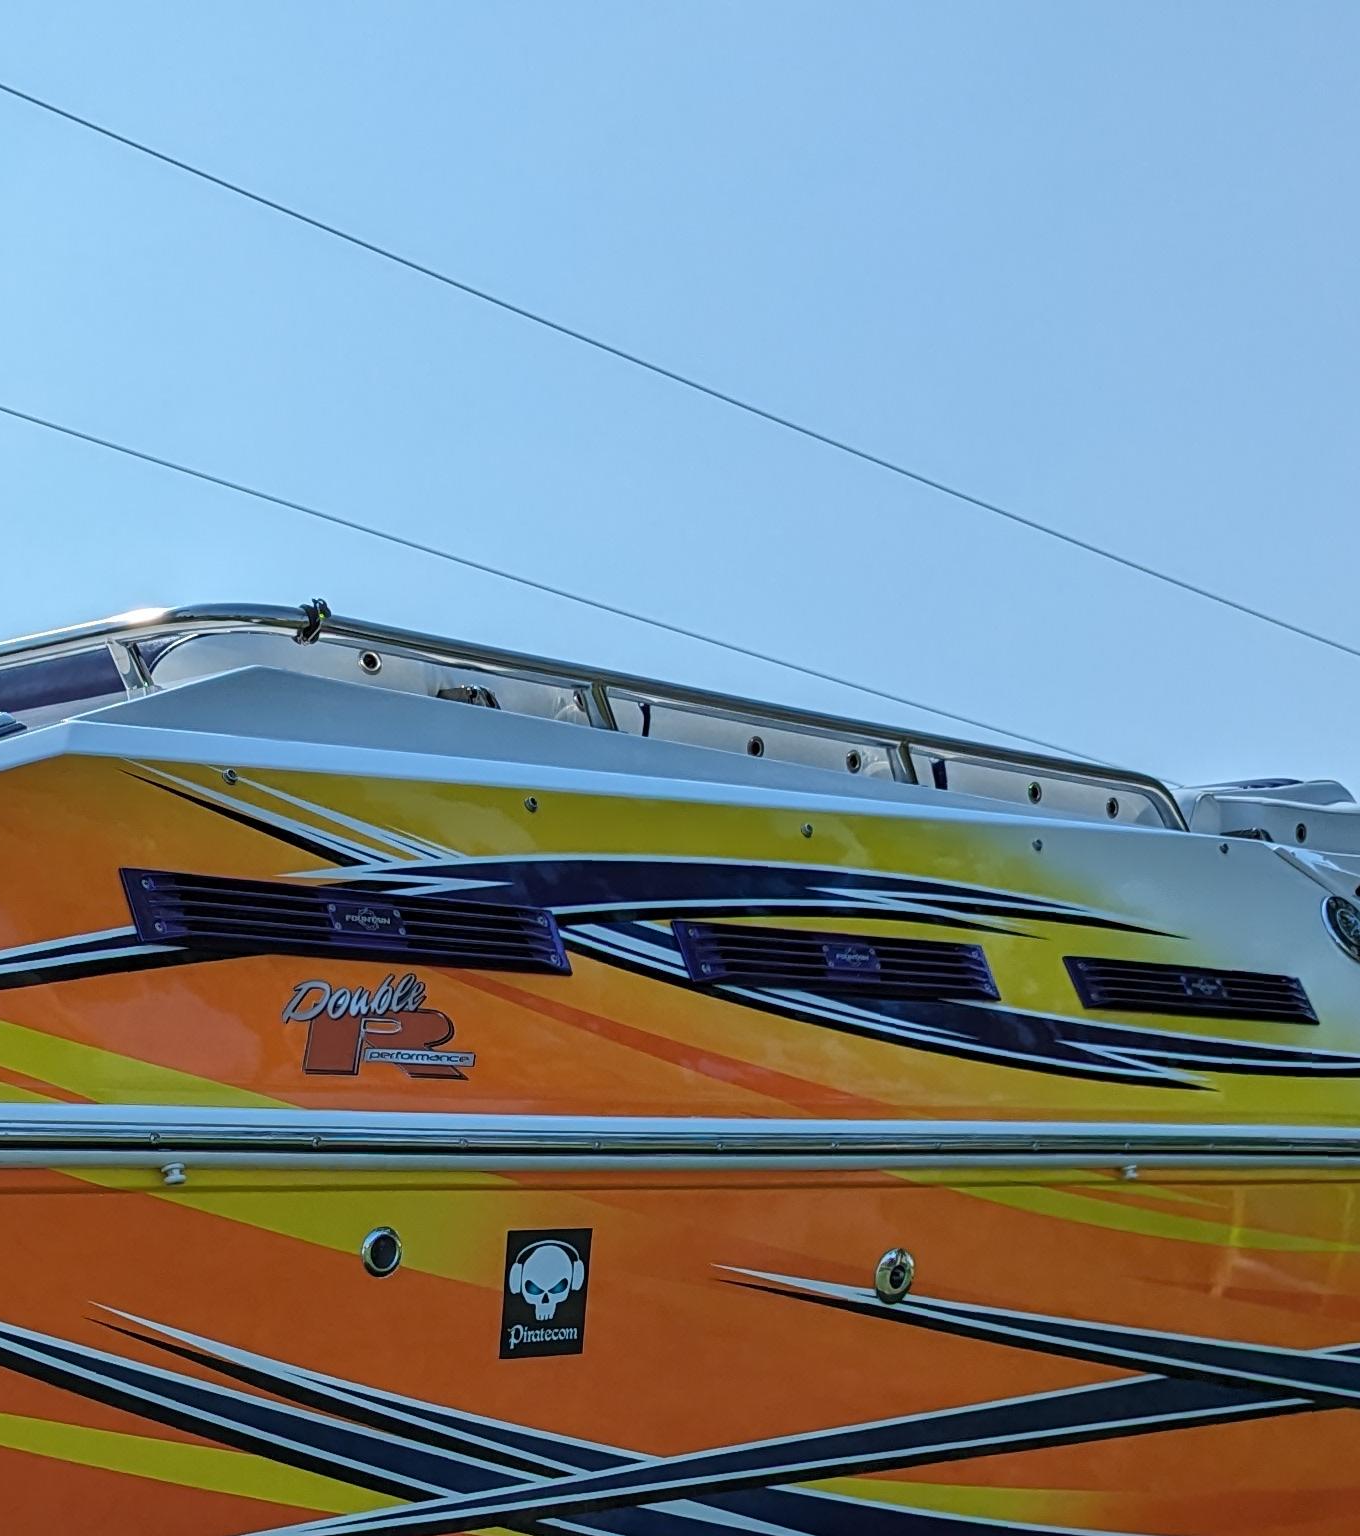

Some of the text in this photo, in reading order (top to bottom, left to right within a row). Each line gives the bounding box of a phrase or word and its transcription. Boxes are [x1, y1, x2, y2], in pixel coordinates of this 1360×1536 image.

[282, 973, 428, 1024] Double
[368, 1049, 471, 1063] performance
[507, 1324, 578, 1350] Piratecom
